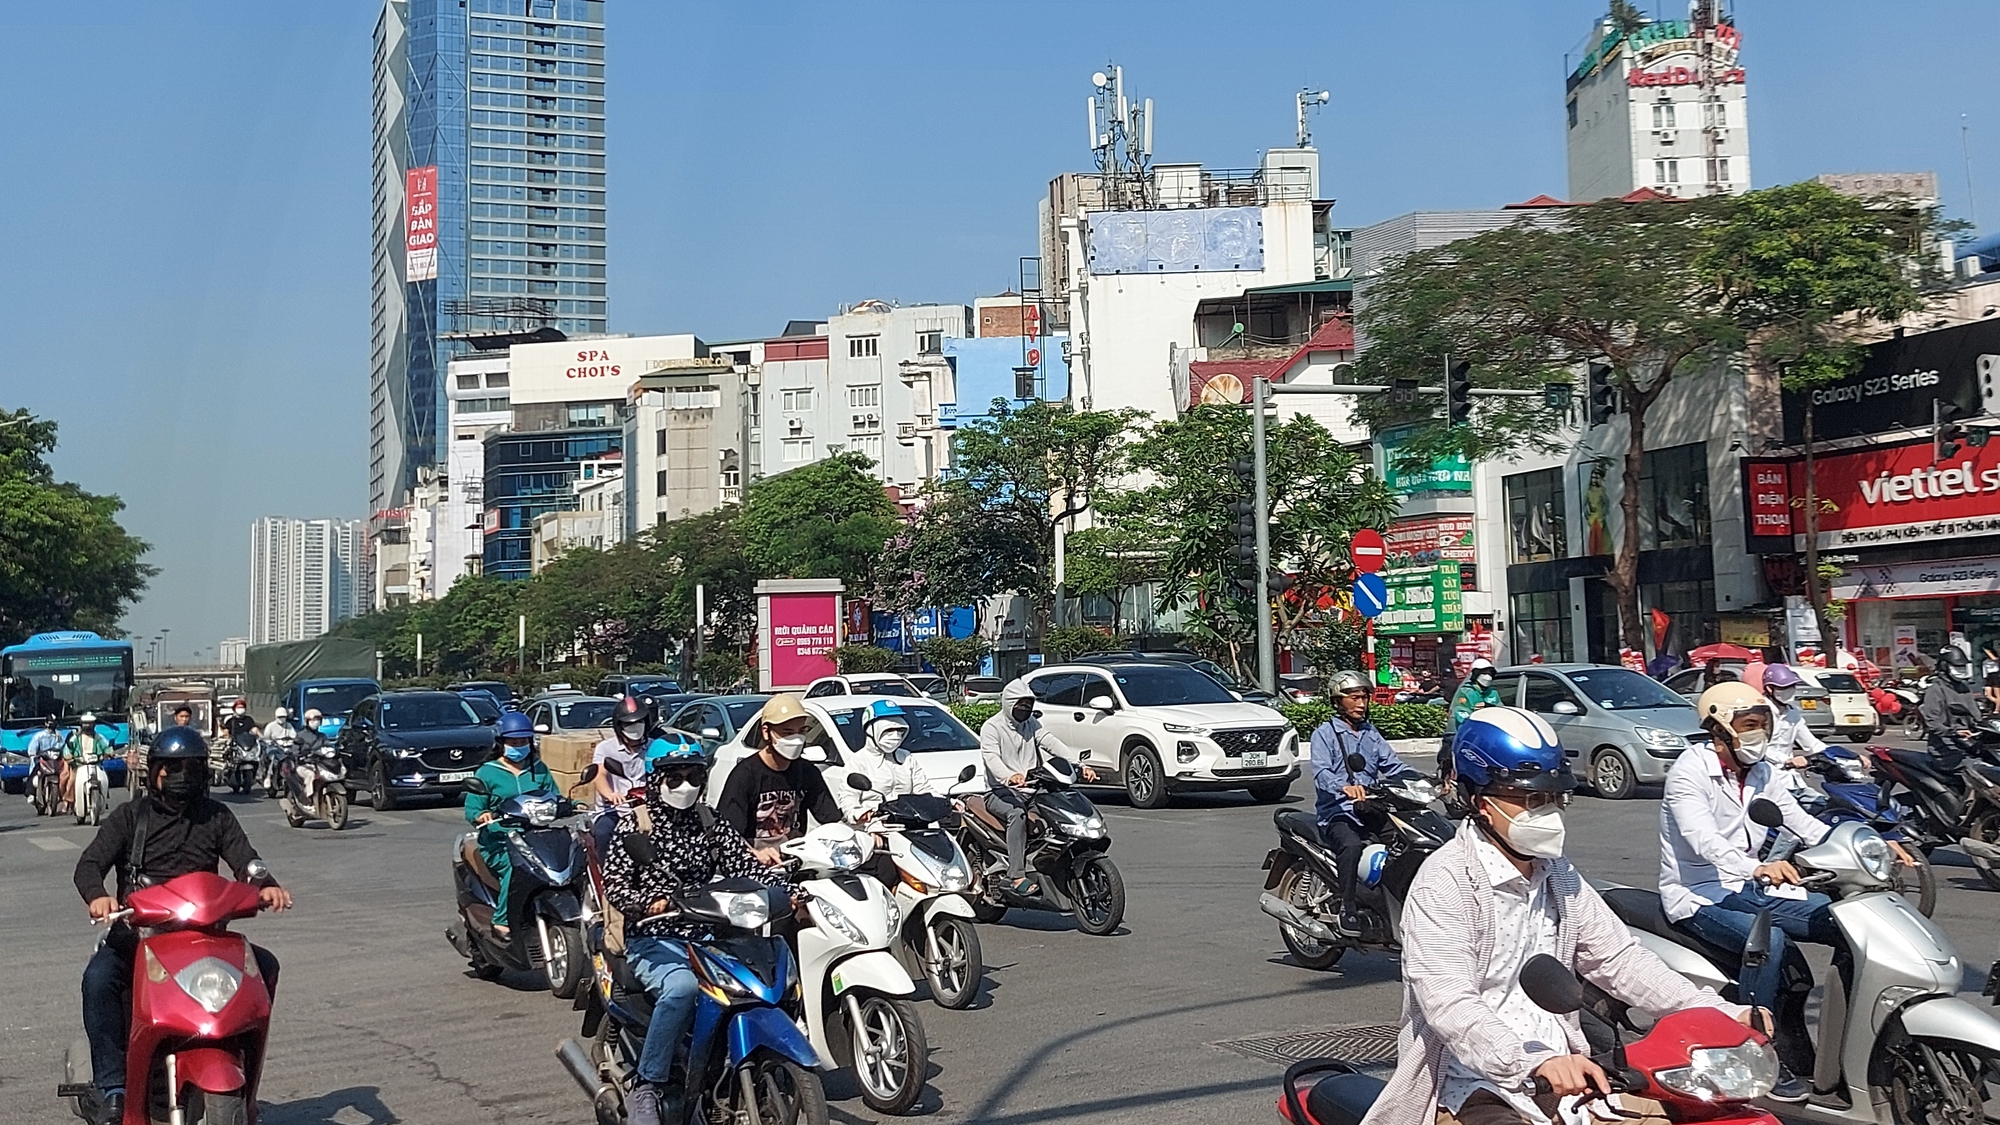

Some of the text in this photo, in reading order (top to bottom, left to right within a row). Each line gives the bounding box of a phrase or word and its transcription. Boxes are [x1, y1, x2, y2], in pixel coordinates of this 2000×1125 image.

[411, 217, 433, 231] BÀN
[409, 233, 435, 246] GIAO
[577, 350, 610, 362] SPA
[566, 365, 621, 378] CHOI'S
[1812, 368, 1940, 405] Galaxy S23 Series
[1757, 470, 1782, 484] BÁN
[1858, 461, 1980, 504] viettel
[1758, 491, 1784, 507] ĐIỆN
[1755, 514, 1790, 528] THOẠI
[1441, 550, 1475, 558] CHERRY
[818, 623, 834, 634] CÁO
